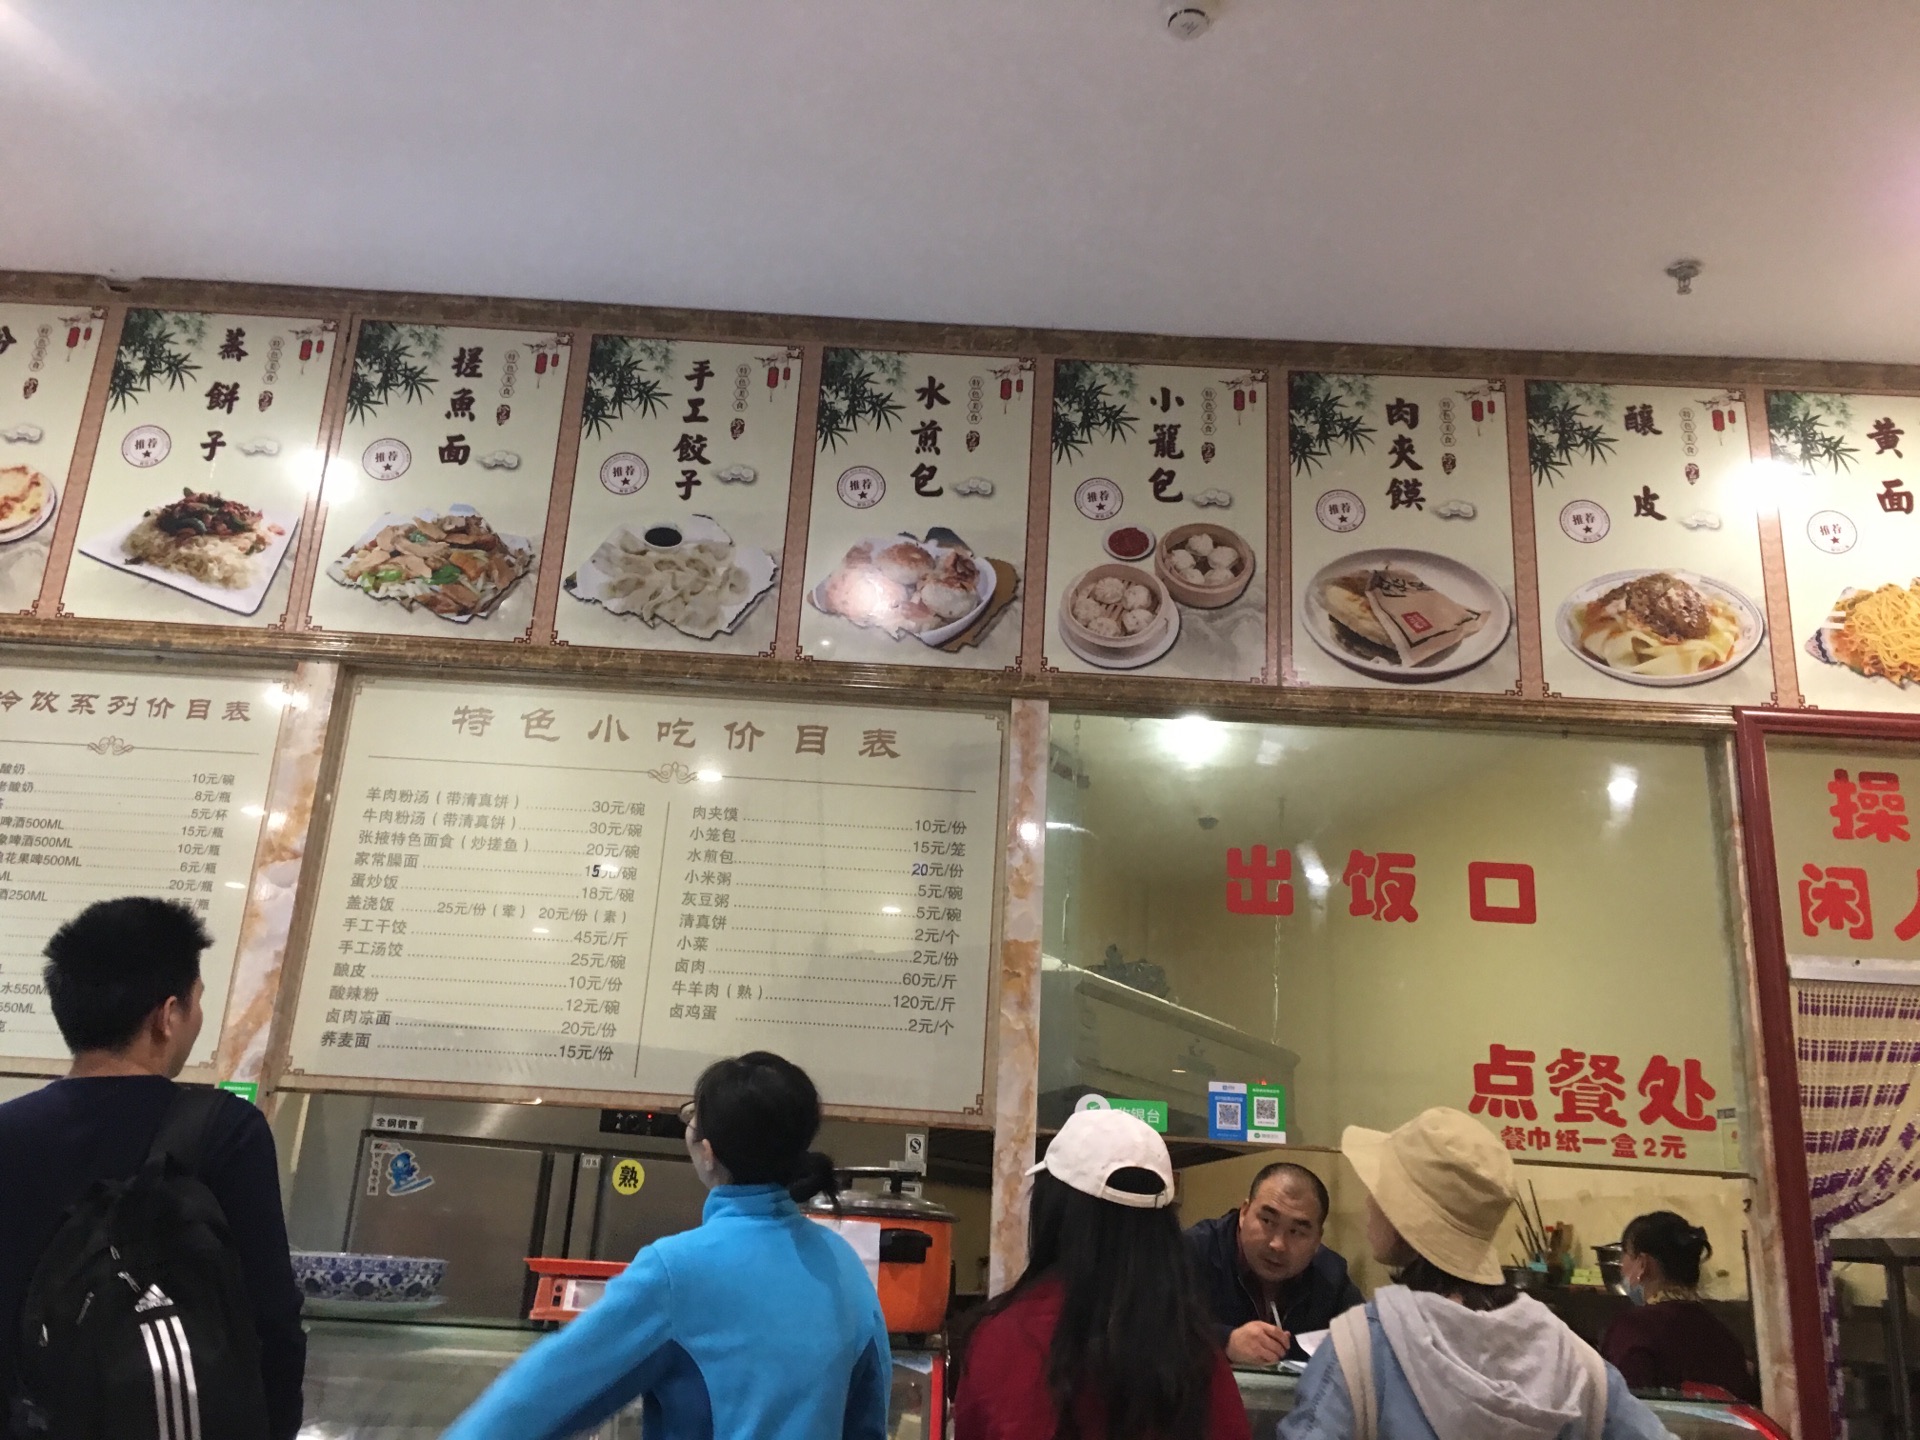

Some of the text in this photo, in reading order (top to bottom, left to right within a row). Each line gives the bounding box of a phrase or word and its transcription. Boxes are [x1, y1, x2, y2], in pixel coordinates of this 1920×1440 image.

[673, 359, 715, 501] 手工餃子
[910, 375, 951, 497] 水煎包
[1148, 386, 1185, 503] 小籠包
[375, 450, 398, 463] 推荐
[1385, 397, 1426, 511] 肉夾饃
[1866, 416, 1914, 515] 黄面
[612, 465, 635, 478] 推荐
[849, 478, 872, 491] 推荐
[1087, 490, 1110, 503] 推荐
[1328, 502, 1352, 515] 推荐
[1572, 512, 1595, 526] 推荐
[0, 689, 252, 722] 冷饮系列价目表
[452, 705, 901, 760] 特色小吃价目表
[192, 773, 235, 786] 10元/碗
[194, 790, 231, 803] 8元/瓶
[592, 801, 646, 817] 30元/碗
[1827, 768, 1911, 843] 操
[191, 808, 228, 821] 5元/杯
[692, 806, 967, 835] 肉夹馍 10元/份
[182, 826, 224, 838] 15元/瓶
[589, 822, 643, 838] 30元/碗
[689, 827, 966, 857] 小笼包 15元/笼
[178, 843, 220, 856] 10元/瓶
[586, 843, 640, 860] 20元/碗
[687, 848, 964, 878] 水煎包 20元/份
[180, 861, 217, 874] 6元/瓶
[584, 864, 637, 880] 15元/碗
[169, 879, 213, 892] 20元/瓶
[350, 873, 635, 902] 蛋炒饭 18元/碗
[684, 870, 963, 901] 小米粥 5元/碗
[1226, 844, 1538, 926] 出饭口
[346, 895, 395, 912] 盖浇饭
[681, 891, 962, 922] 灰豆粥 5元/碗
[342, 917, 629, 947] 手工干饺 45元/斤
[679, 913, 960, 945] 清真饼 2元/个
[338, 939, 626, 970] 手工汤饺 25元/碗
[676, 936, 959, 967] 小菜 2元/份
[333, 962, 623, 992] 酿皮 10元/份
[675, 958, 958, 990] 卤肉 60元/斤
[329, 986, 620, 1015] 酸辣粉 12元/碗
[893, 996, 956, 1012] 120元/斤
[325, 1008, 617, 1038] 卤肉凉面 20元/份
[669, 1004, 954, 1036] 卤鸡蛋 2元/个
[321, 1030, 614, 1061] 荞麦面 15元/份
[1468, 1044, 1717, 1131] 点餐处
[1501, 1125, 1687, 1159] 餐巾纸一盒2元
[618, 1166, 639, 1188] 熟
